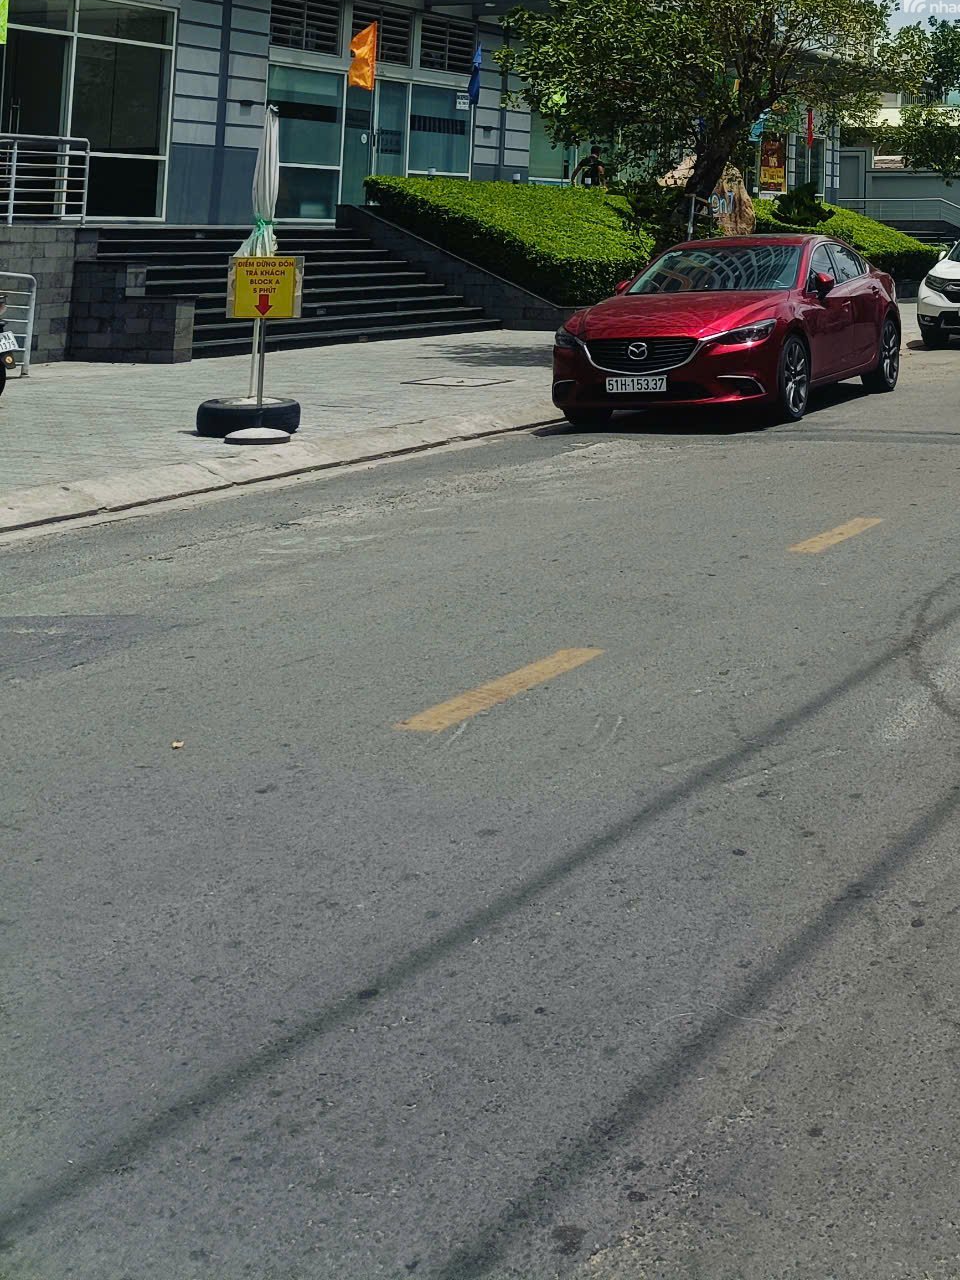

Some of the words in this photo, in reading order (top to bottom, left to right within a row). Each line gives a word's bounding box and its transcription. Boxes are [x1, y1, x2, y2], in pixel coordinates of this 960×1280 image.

[260, 268, 286, 276] KHÁCH
[259, 286, 277, 294] PHÚT
[607, 377, 665, 392] 51H-153.37
